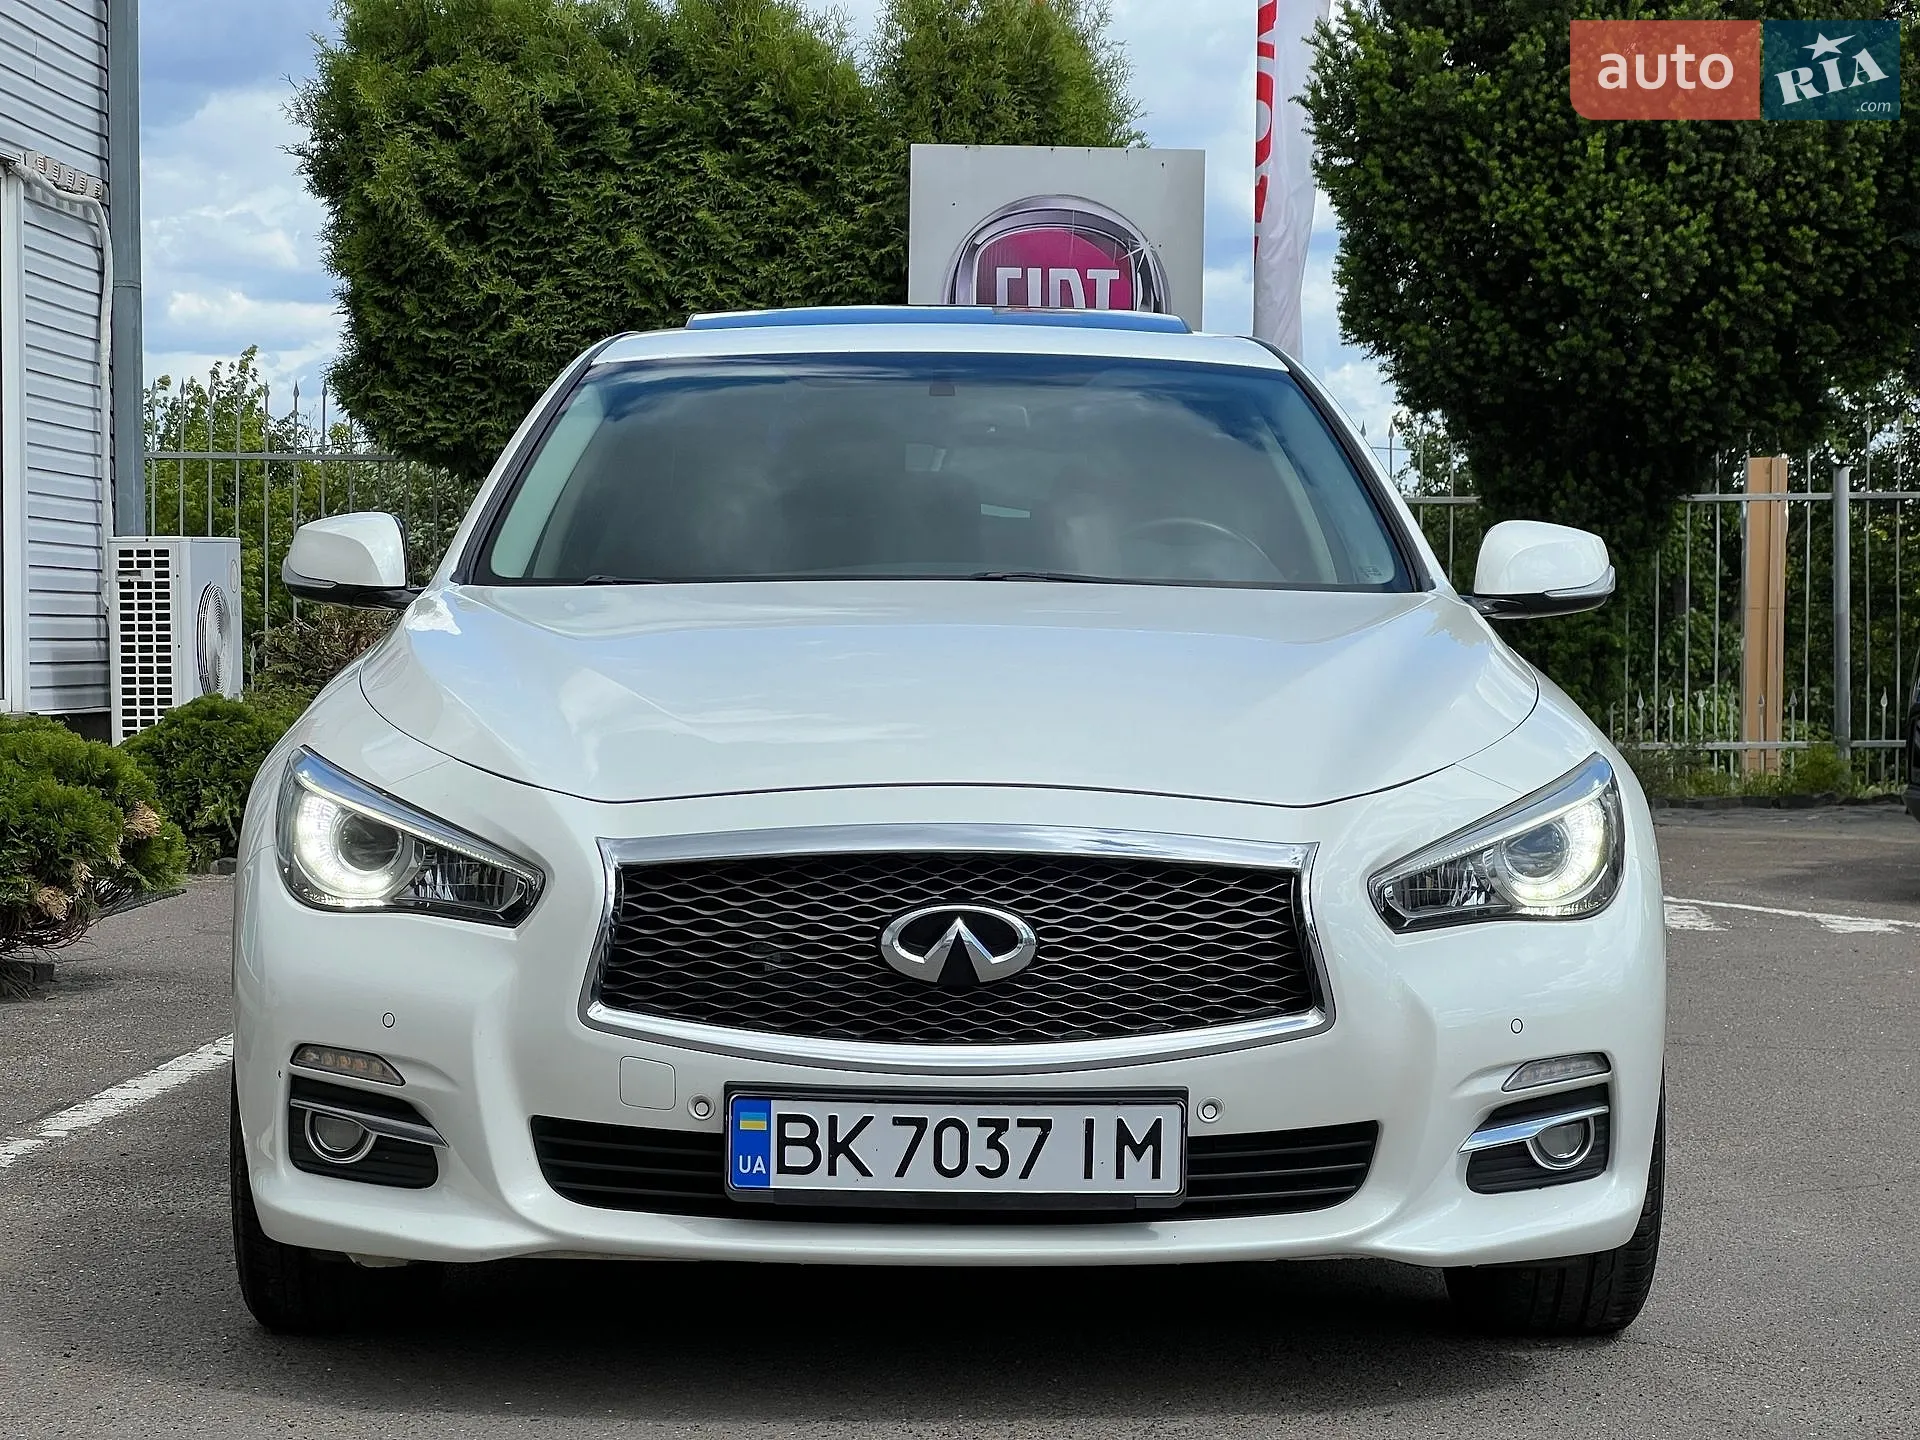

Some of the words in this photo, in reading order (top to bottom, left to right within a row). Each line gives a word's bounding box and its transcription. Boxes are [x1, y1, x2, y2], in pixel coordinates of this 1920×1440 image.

[739, 1155, 767, 1174] UA
[775, 1112, 875, 1178] BK
[892, 1115, 1053, 1180] 7037
[1083, 1117, 1163, 1181] IM
